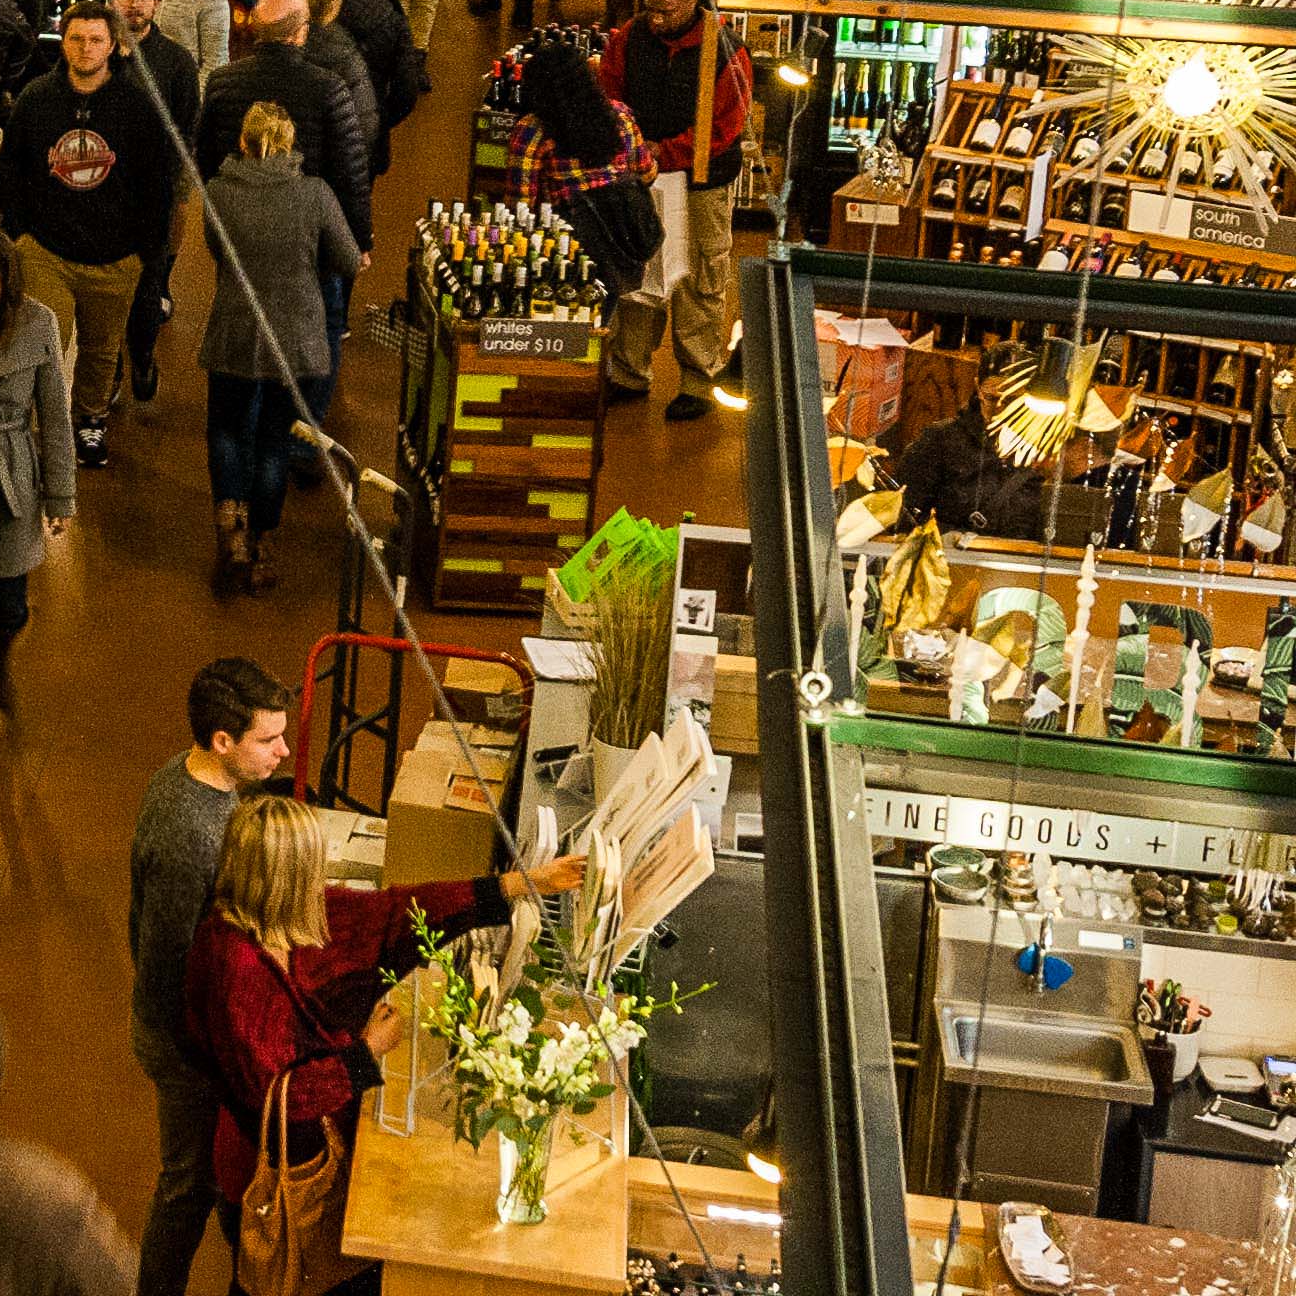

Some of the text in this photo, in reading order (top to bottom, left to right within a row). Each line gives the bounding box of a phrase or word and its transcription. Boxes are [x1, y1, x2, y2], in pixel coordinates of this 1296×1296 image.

[1194, 207, 1241, 227] south
[1193, 228, 1266, 249] america
[484, 322, 533, 336] whites
[484, 338, 564, 353] under $10
[979, 811, 1111, 851] GOODS
